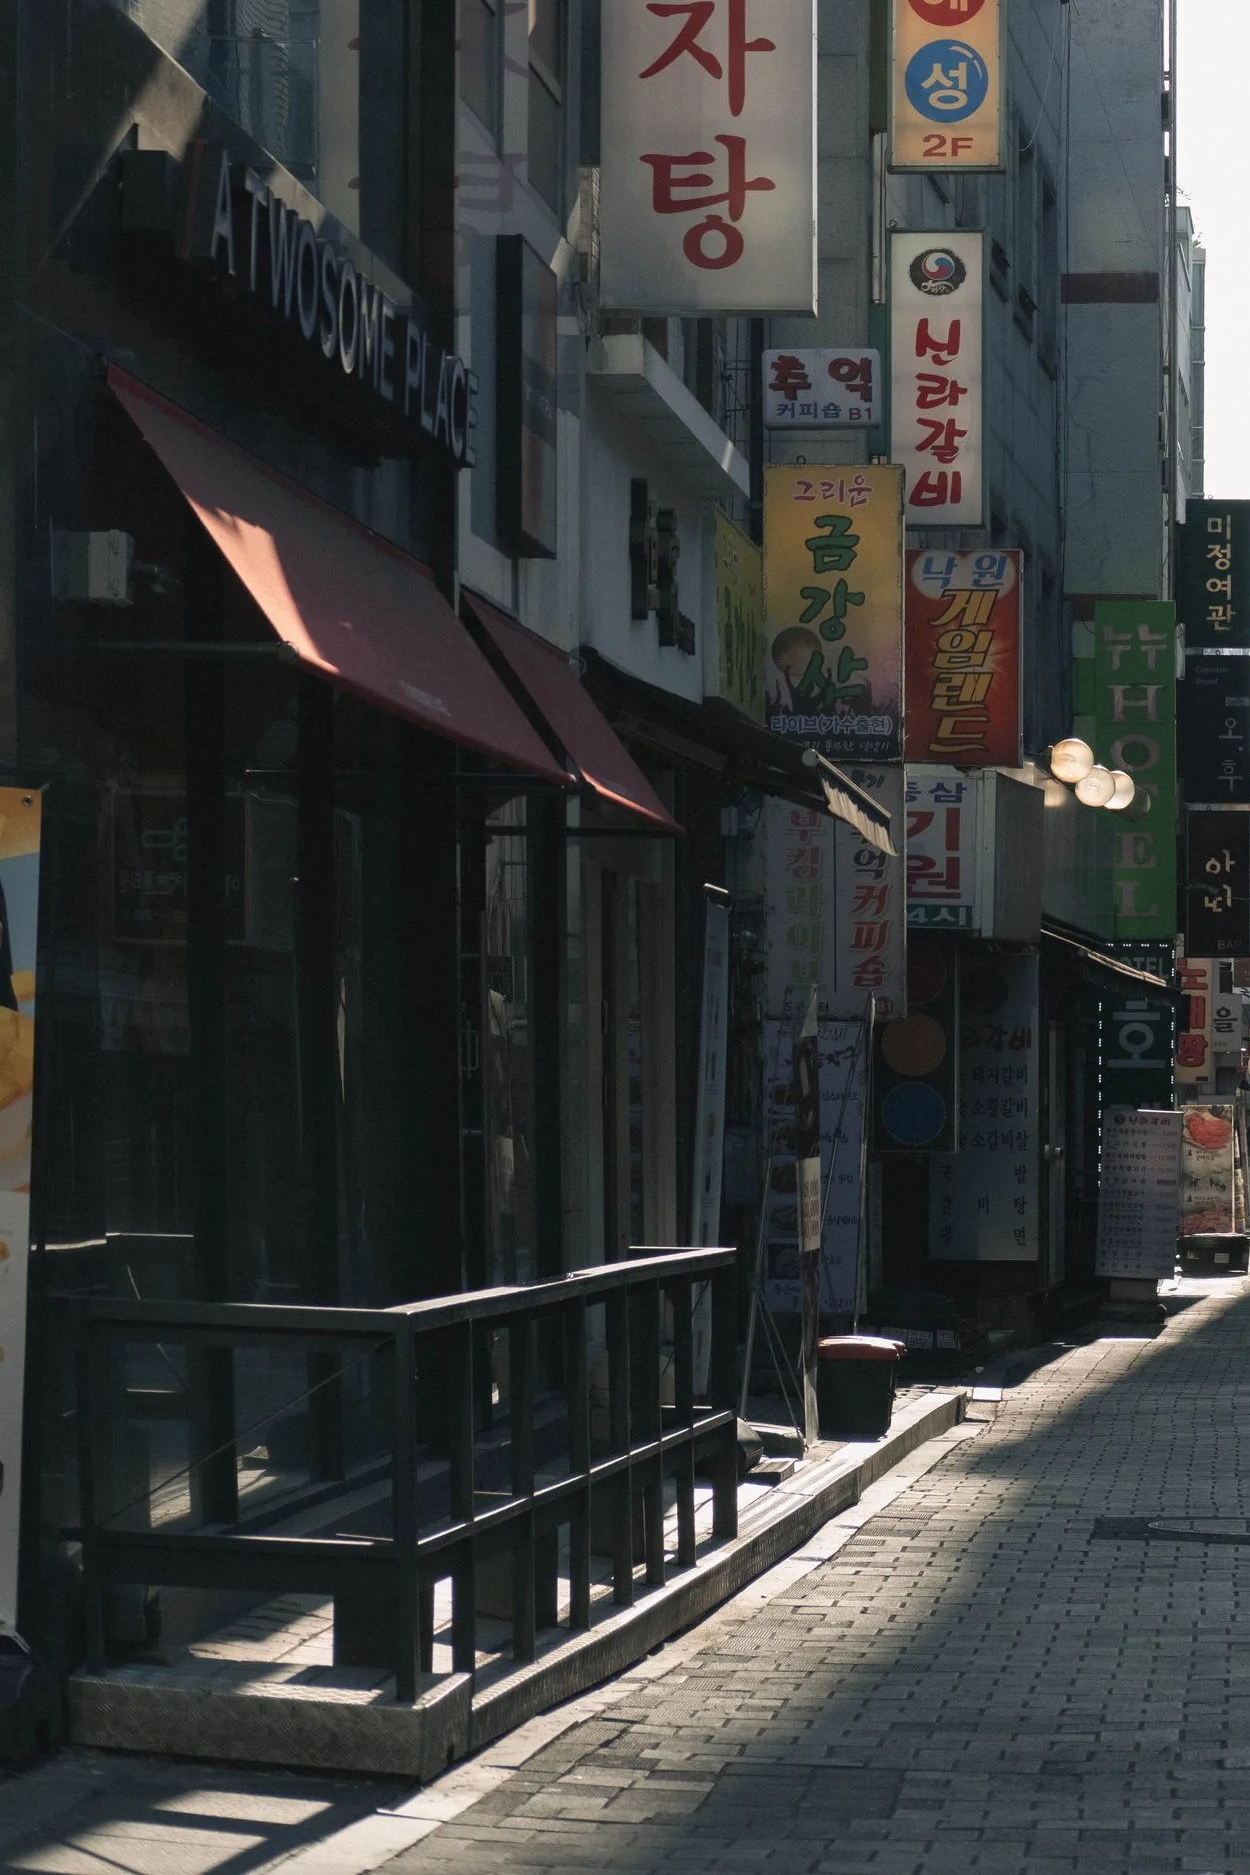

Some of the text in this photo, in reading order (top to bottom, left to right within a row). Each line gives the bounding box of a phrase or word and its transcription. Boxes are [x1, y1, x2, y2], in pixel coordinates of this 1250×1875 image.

[921, 132, 975, 159] 2F
[211, 148, 480, 470] A TWOSOME PLACE
[768, 354, 874, 404] 추억
[776, 401, 873, 421] 커피숍 B1
[908, 317, 968, 508] 신라갈비
[793, 474, 873, 508] 그리운
[921, 554, 1008, 590] 낙원
[1205, 514, 1236, 631] 미정여관
[798, 513, 869, 707] 금강산
[927, 588, 1001, 753] 게임랜드
[906, 808, 962, 900] 기원
[906, 905, 968, 925] 4시
[1217, 938, 1243, 951] BAR
[959, 1022, 1033, 1052] 라갈비
